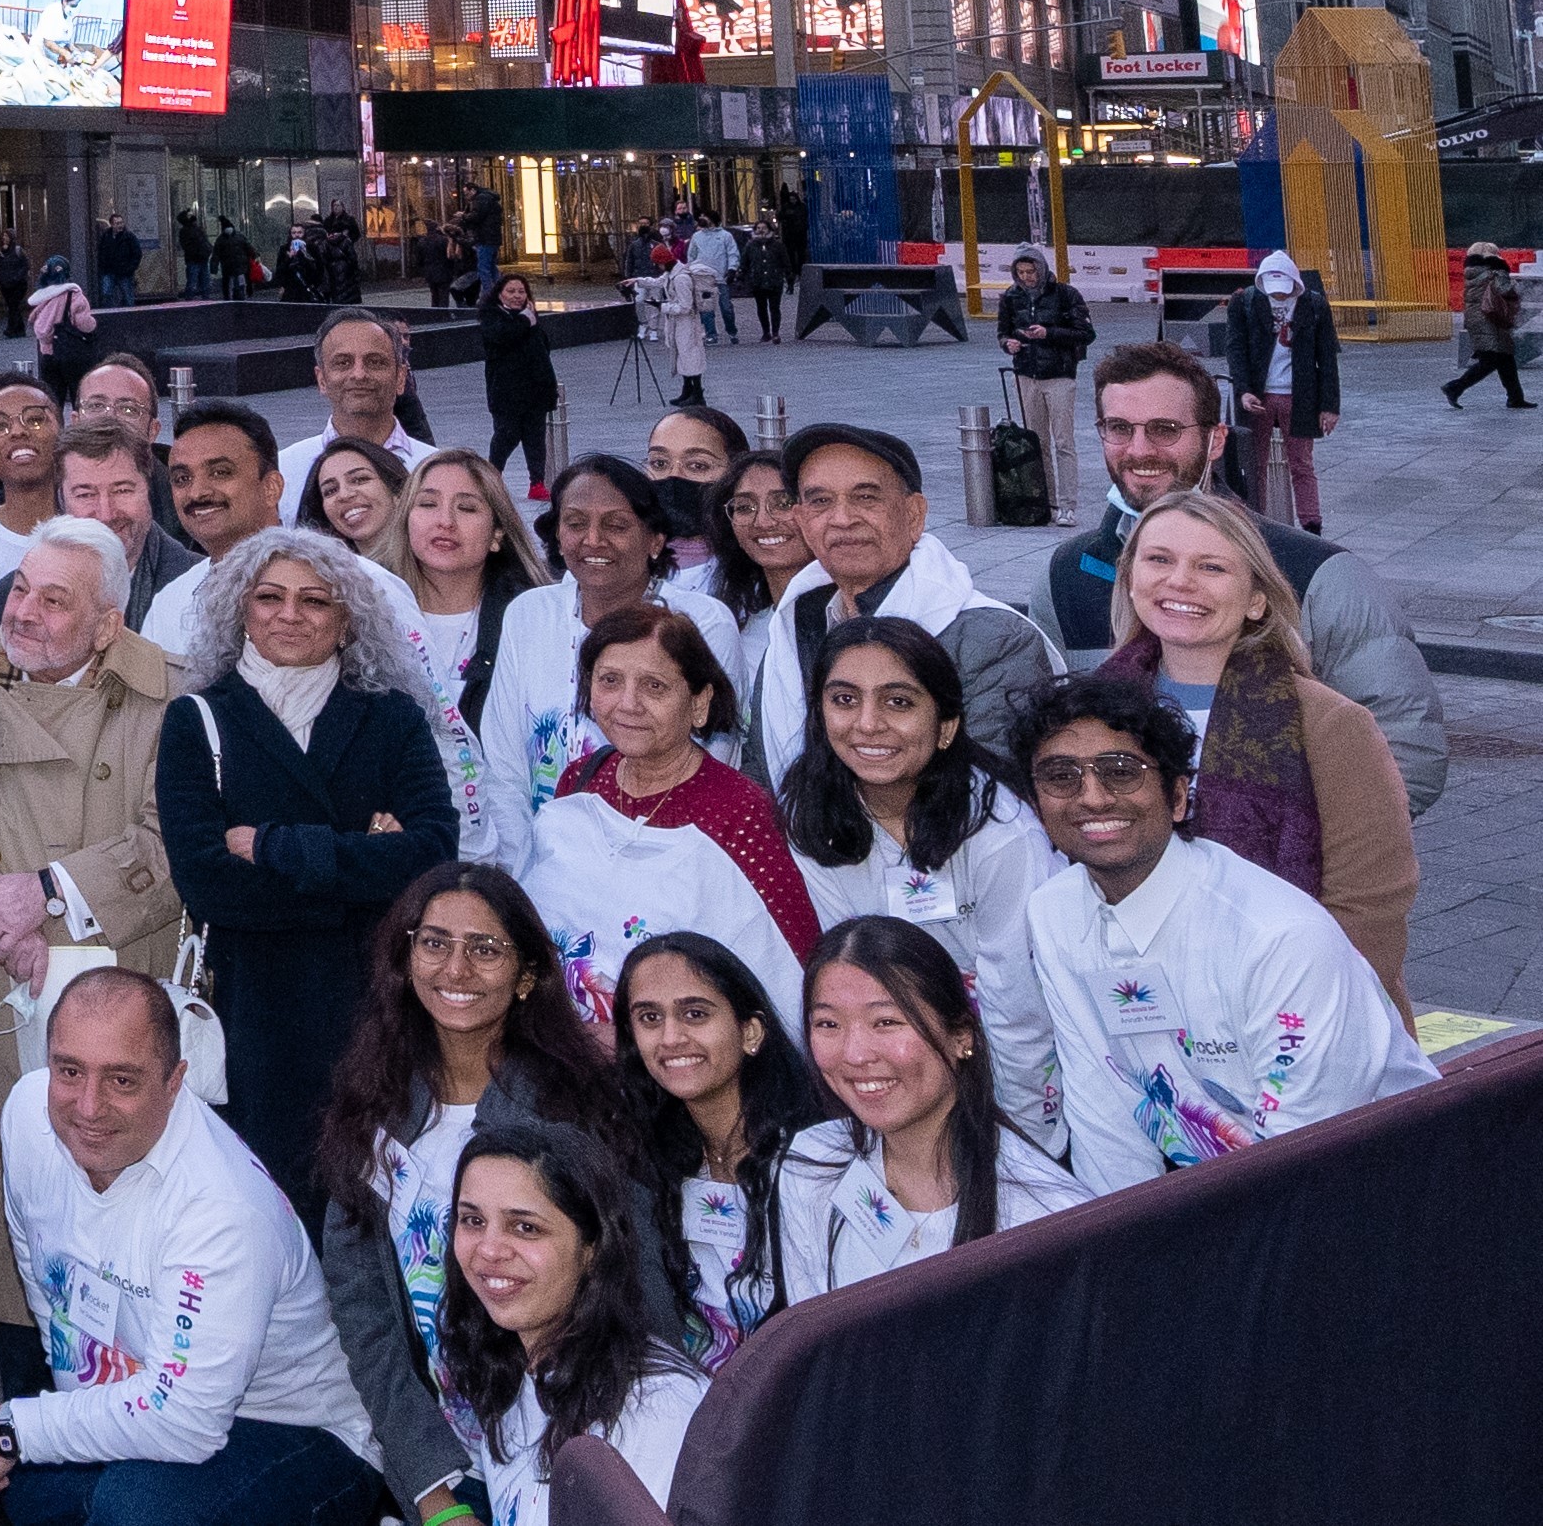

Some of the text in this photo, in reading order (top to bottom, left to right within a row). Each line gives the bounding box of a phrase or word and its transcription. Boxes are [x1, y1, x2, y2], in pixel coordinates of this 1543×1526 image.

[490, 17, 537, 49] H&M
[1106, 58, 1202, 74] Foot Locker
